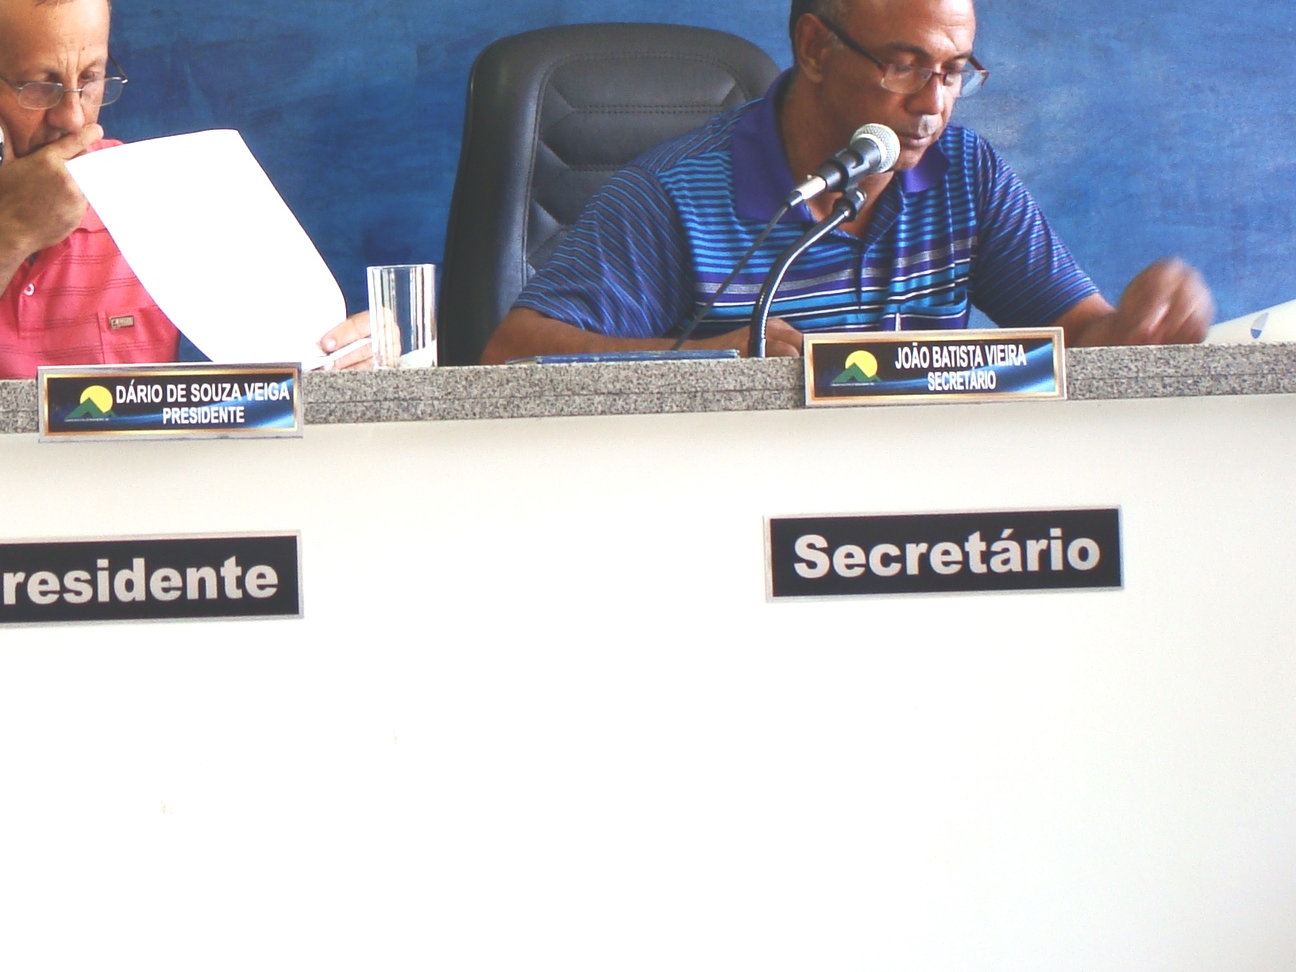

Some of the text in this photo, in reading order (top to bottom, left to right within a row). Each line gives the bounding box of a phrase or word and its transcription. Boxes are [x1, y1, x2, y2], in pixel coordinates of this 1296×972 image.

[895, 342, 1026, 369] JOÃO BATISTA VIEIRA
[927, 366, 996, 391] SECRETÁRIO
[116, 380, 290, 404] DÁRIO DE SOUZA VEIGA
[163, 406, 245, 424] PRESIDENTE
[794, 528, 1100, 578] Secretário
